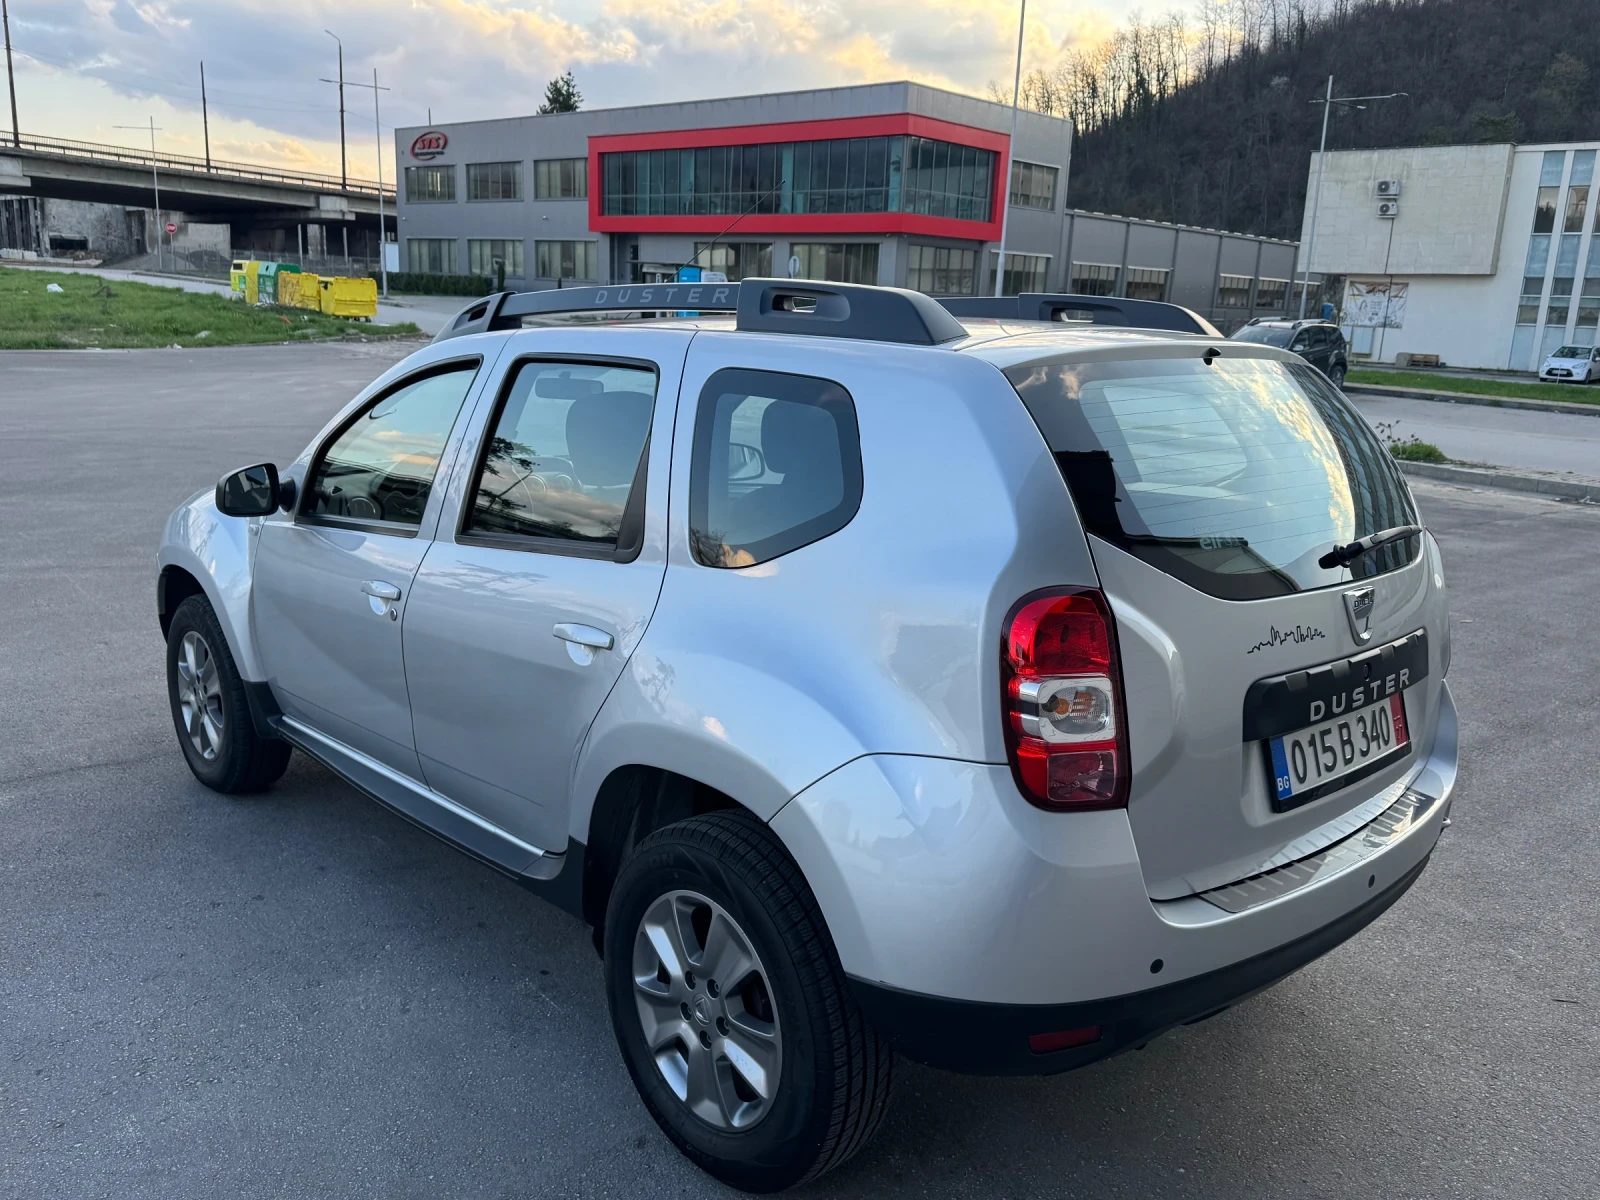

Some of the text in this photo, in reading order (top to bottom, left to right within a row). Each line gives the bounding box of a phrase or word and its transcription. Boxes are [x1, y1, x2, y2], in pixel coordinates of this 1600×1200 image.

[417, 137, 440, 149] STS
[595, 288, 729, 303] DUSTER
[1310, 668, 1409, 721] DUSTER
[1277, 776, 1290, 791] BG
